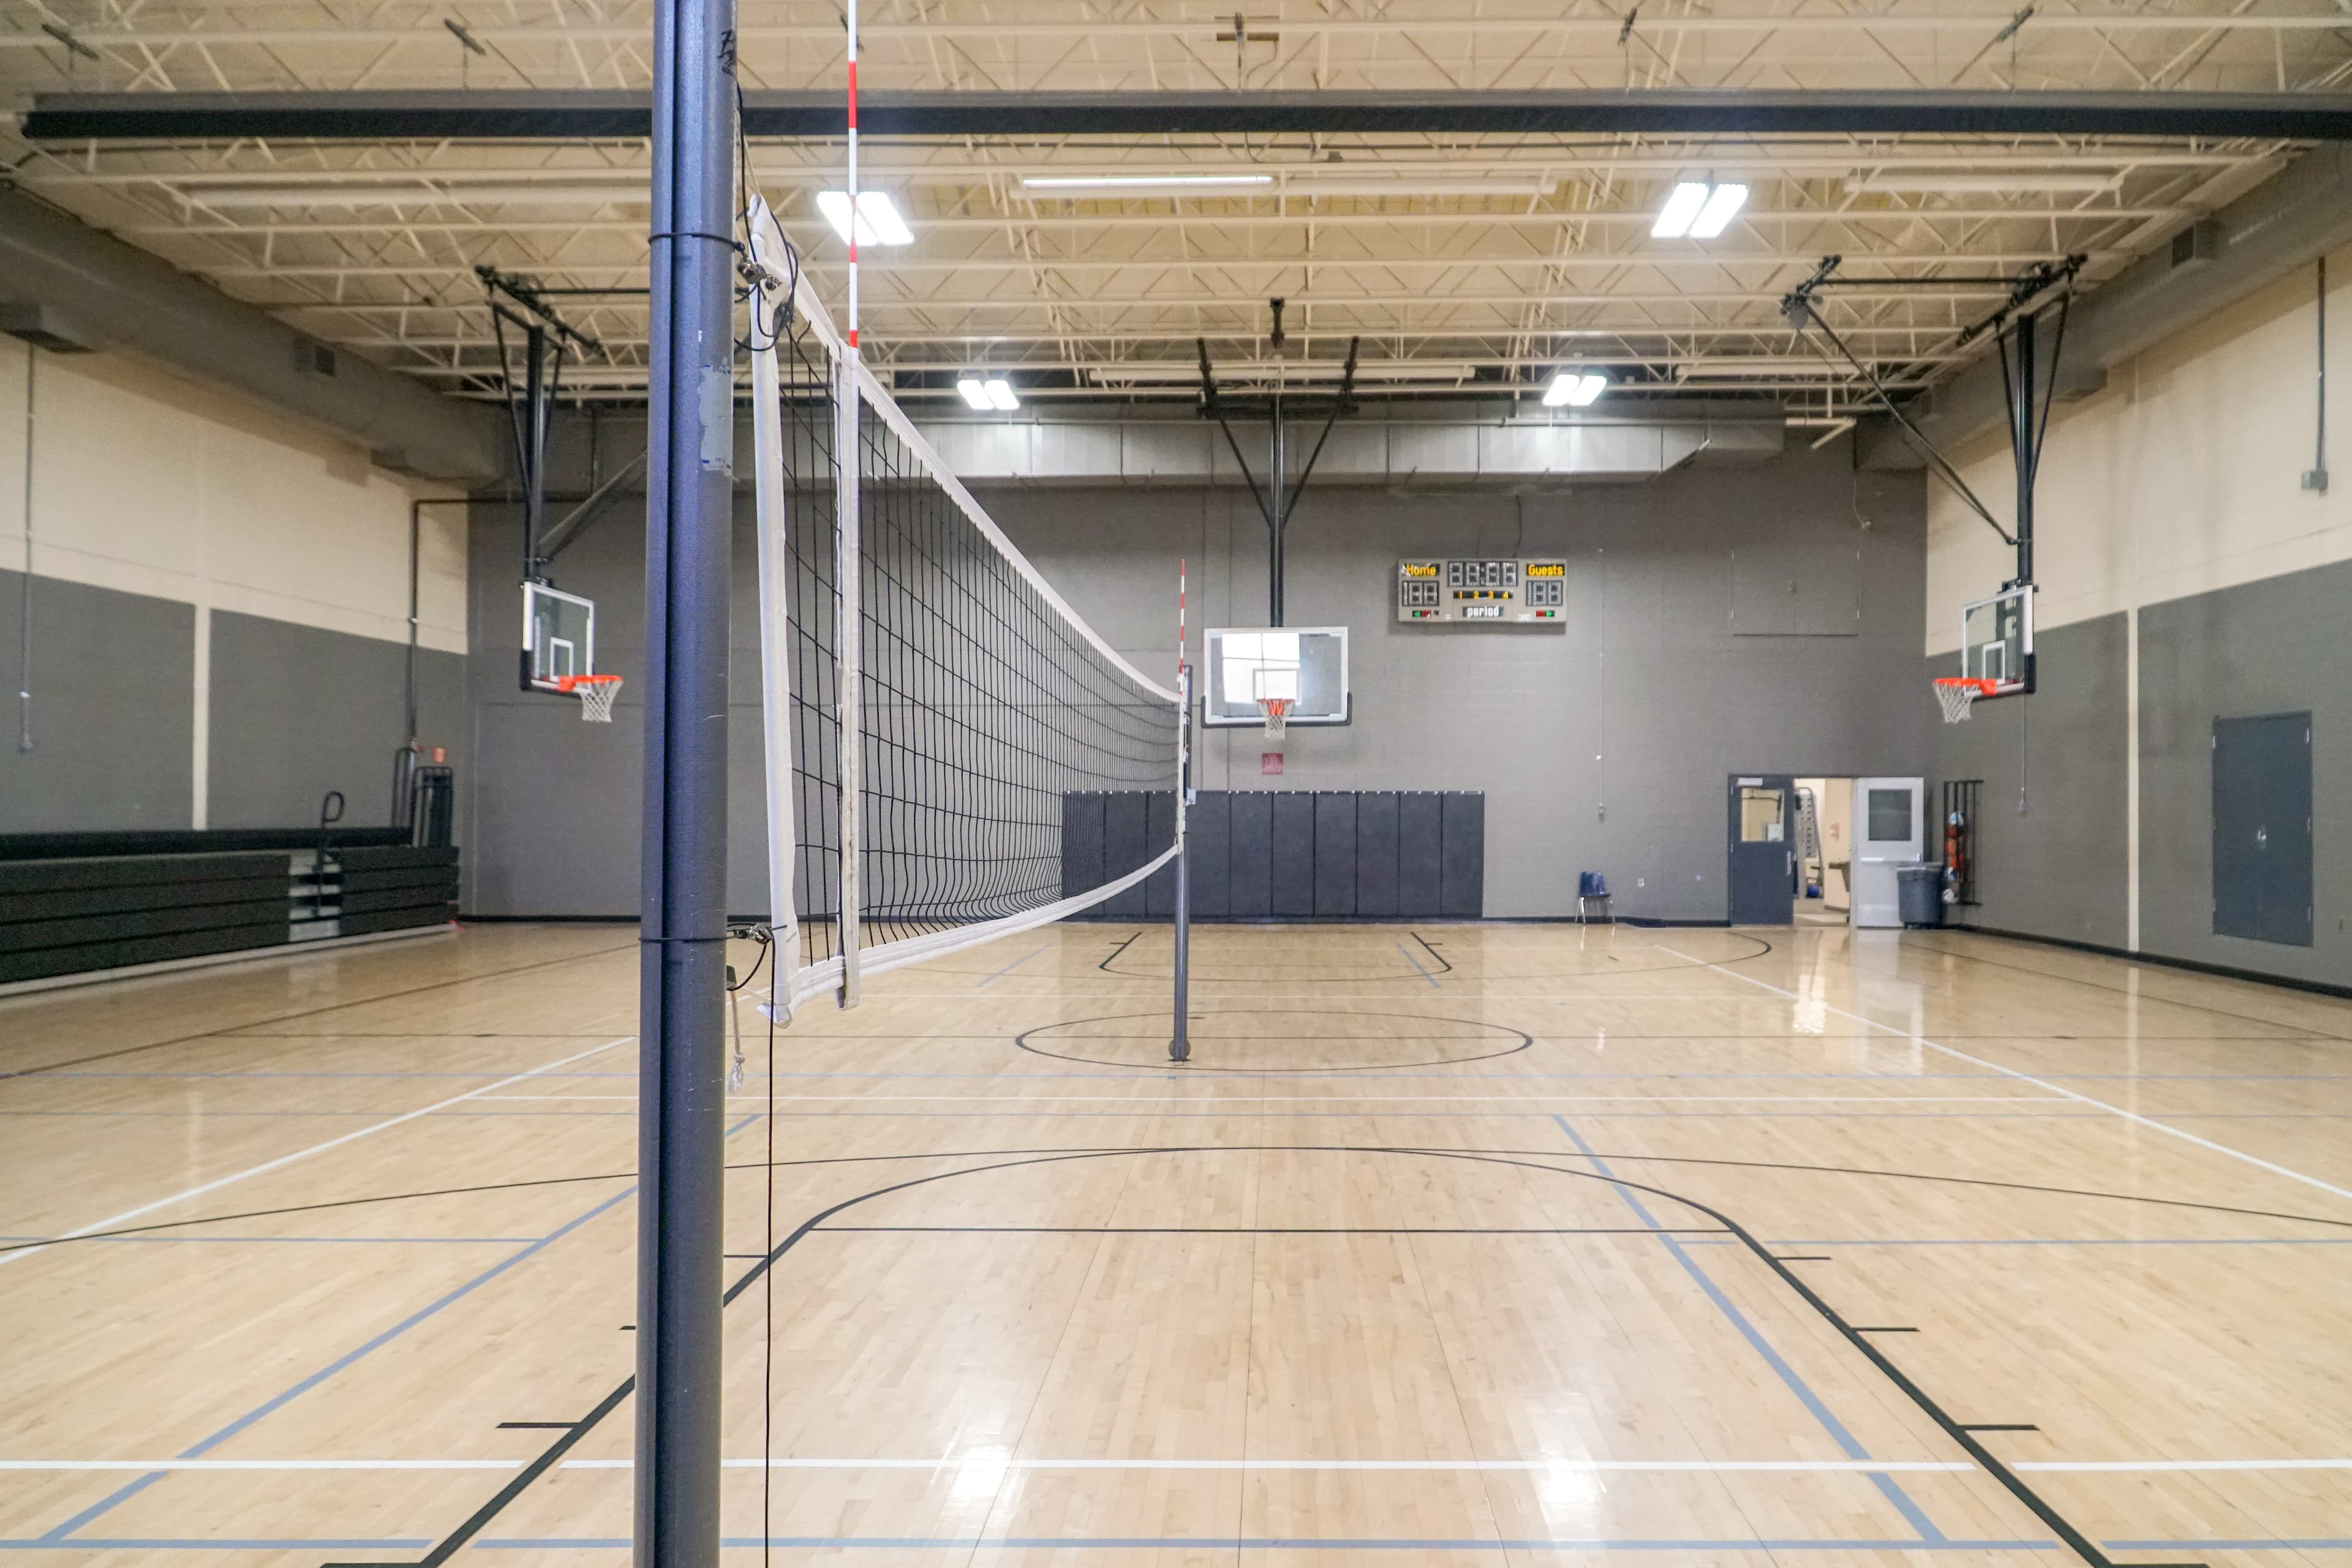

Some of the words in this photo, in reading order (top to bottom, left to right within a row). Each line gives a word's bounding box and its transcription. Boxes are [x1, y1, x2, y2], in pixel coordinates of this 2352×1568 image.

[1406, 564, 1436, 576] Home
[1528, 564, 1563, 576] Guests
[1473, 590, 1479, 599] 2
[1488, 590, 1494, 599] 3
[1502, 590, 1509, 599] 4
[1468, 605, 1499, 618] period
